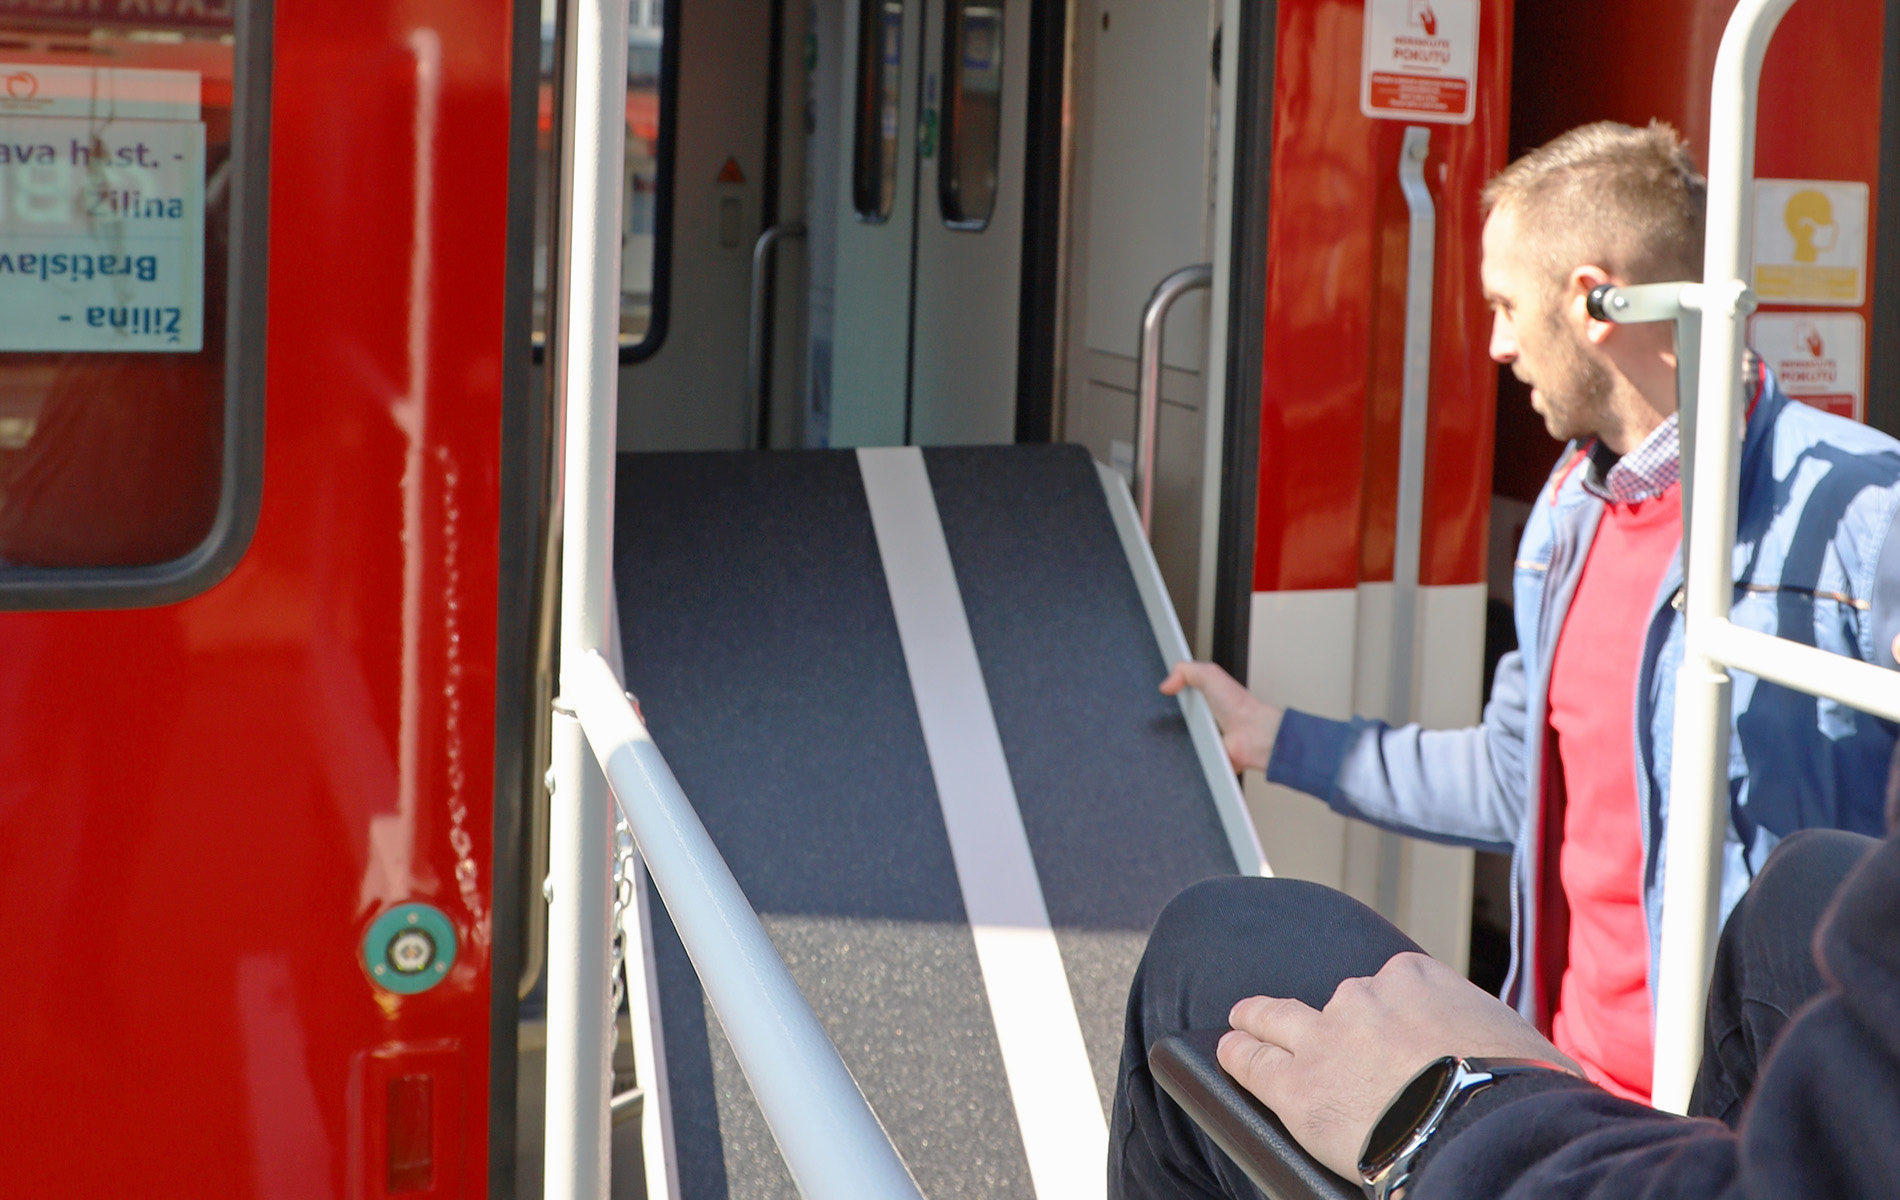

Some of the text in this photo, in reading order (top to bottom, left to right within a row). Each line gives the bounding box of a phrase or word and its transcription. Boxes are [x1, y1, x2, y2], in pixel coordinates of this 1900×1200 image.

[1393, 48, 1451, 63] POKUTU
[71, 139, 160, 168] h.st.
[86, 306, 181, 343] Žilina
